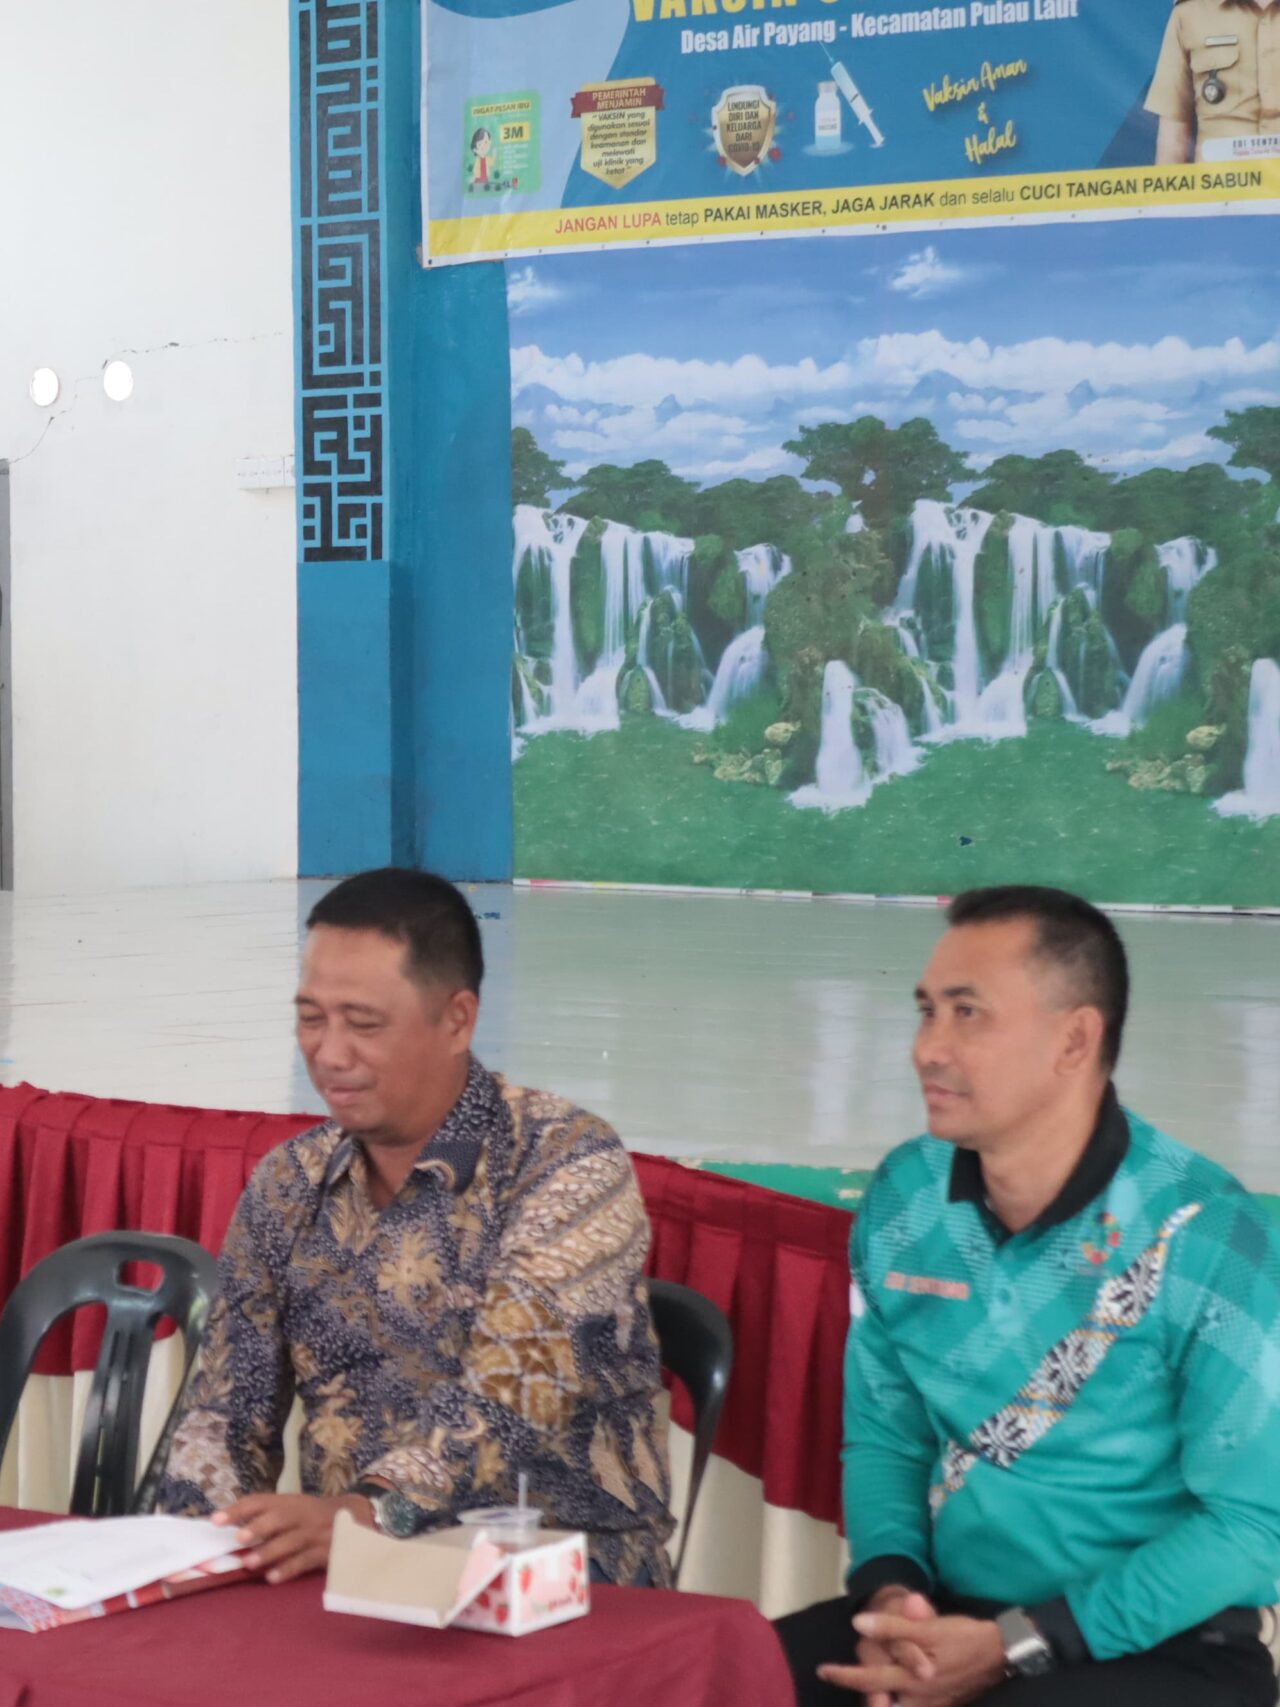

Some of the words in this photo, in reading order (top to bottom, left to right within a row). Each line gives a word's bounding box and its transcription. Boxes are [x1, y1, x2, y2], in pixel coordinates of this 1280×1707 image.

[681, 29, 729, 54] Desa
[732, 24, 761, 49] Air
[763, 19, 836, 46] Payang
[851, 7, 966, 38] Kecamatan
[970, 0, 1029, 27] Pulau
[1034, 0, 1079, 21] Laut
[592, 87, 646, 101] PEMERINTAH
[597, 97, 642, 110] MENJAMIN
[923, 75, 980, 112] Vaksin
[981, 59, 1027, 91] Aman
[503, 126, 524, 140] 3M
[964, 119, 1017, 165] Halal
[555, 215, 618, 234] JANGAN
[622, 212, 662, 229] LUPA
[665, 210, 700, 228] tetap
[704, 206, 751, 223] PAKAI
[755, 200, 827, 220] MASKER,
[831, 197, 875, 214] JAGA
[879, 192, 935, 211] JARAK
[939, 191, 967, 207] dan
[971, 188, 1014, 205] selalu
[1019, 183, 1061, 201] CUCI
[1066, 178, 1137, 198] TANGAN
[1143, 175, 1195, 193] PAKAI
[1200, 171, 1262, 190] SABUN
